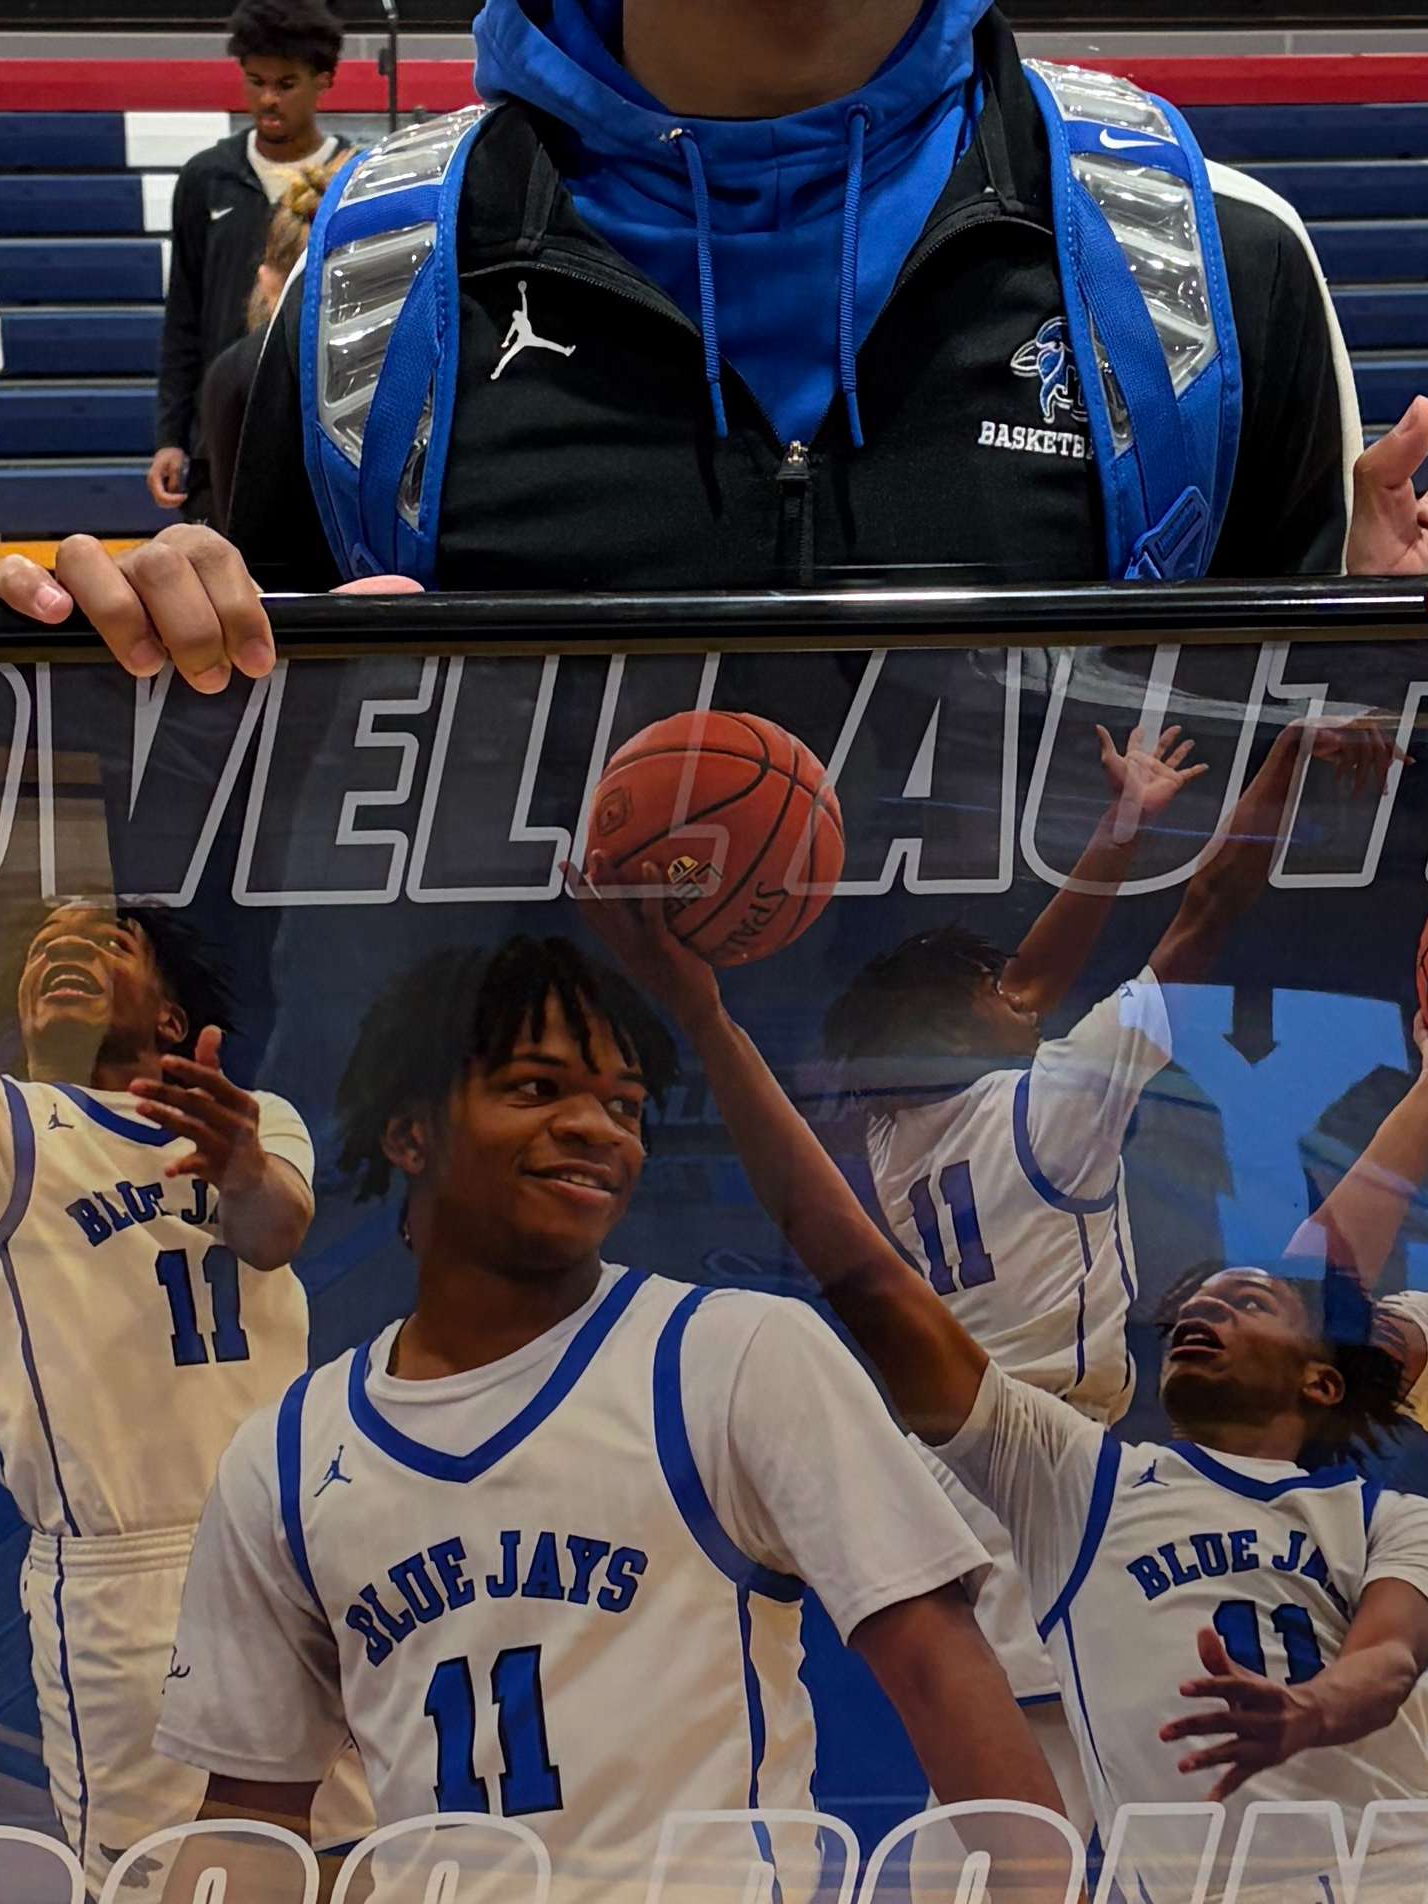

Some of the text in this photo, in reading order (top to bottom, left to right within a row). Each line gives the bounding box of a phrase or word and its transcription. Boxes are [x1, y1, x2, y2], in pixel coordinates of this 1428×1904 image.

[907, 1159, 996, 1297] 11
[154, 1245, 251, 1367] 11
[345, 1529, 650, 1668] BLUE JAYS
[1126, 1529, 1261, 1602] BLUE
[423, 1643, 565, 1818] 11
